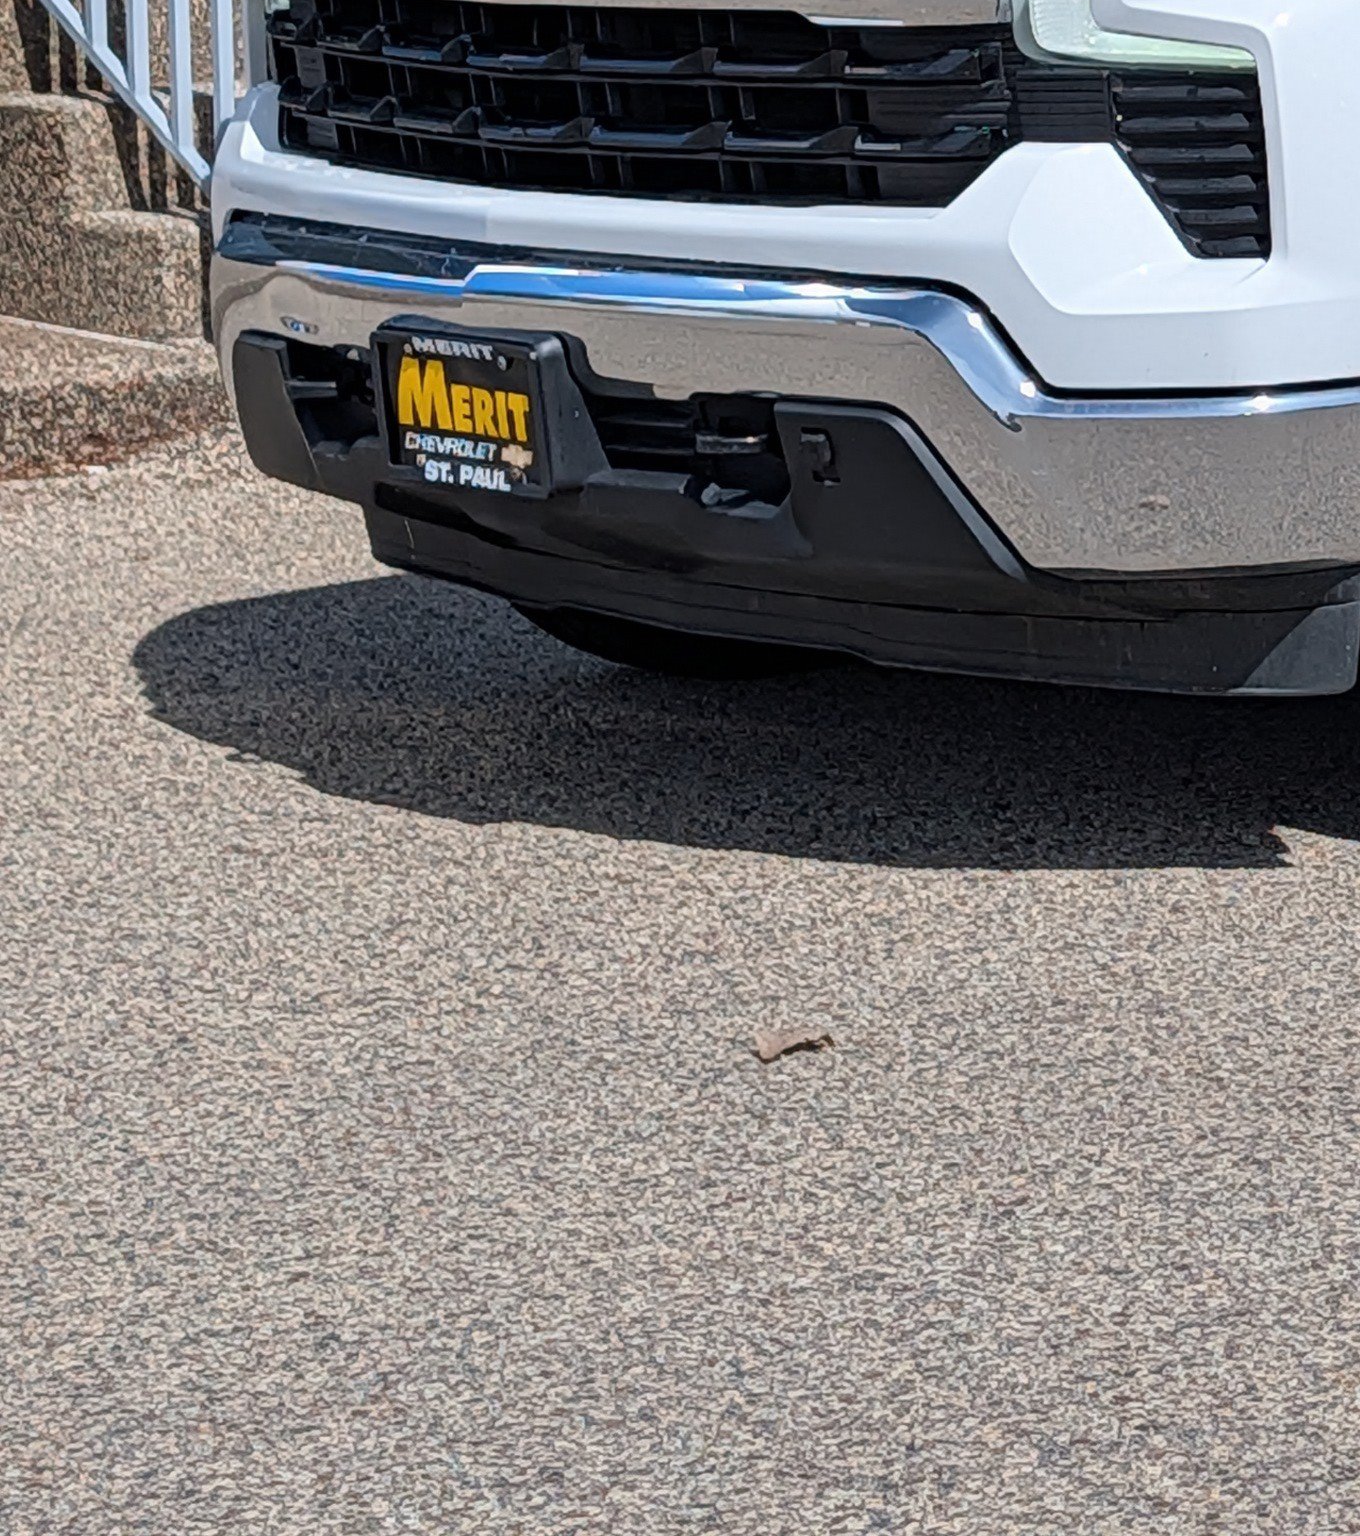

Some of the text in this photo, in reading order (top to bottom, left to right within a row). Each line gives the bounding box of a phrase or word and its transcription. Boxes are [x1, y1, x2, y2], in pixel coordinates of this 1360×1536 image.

[412, 337, 493, 360] MERIT
[405, 432, 497, 462] CHEVROLET
[425, 460, 511, 492] ST. PAUL
